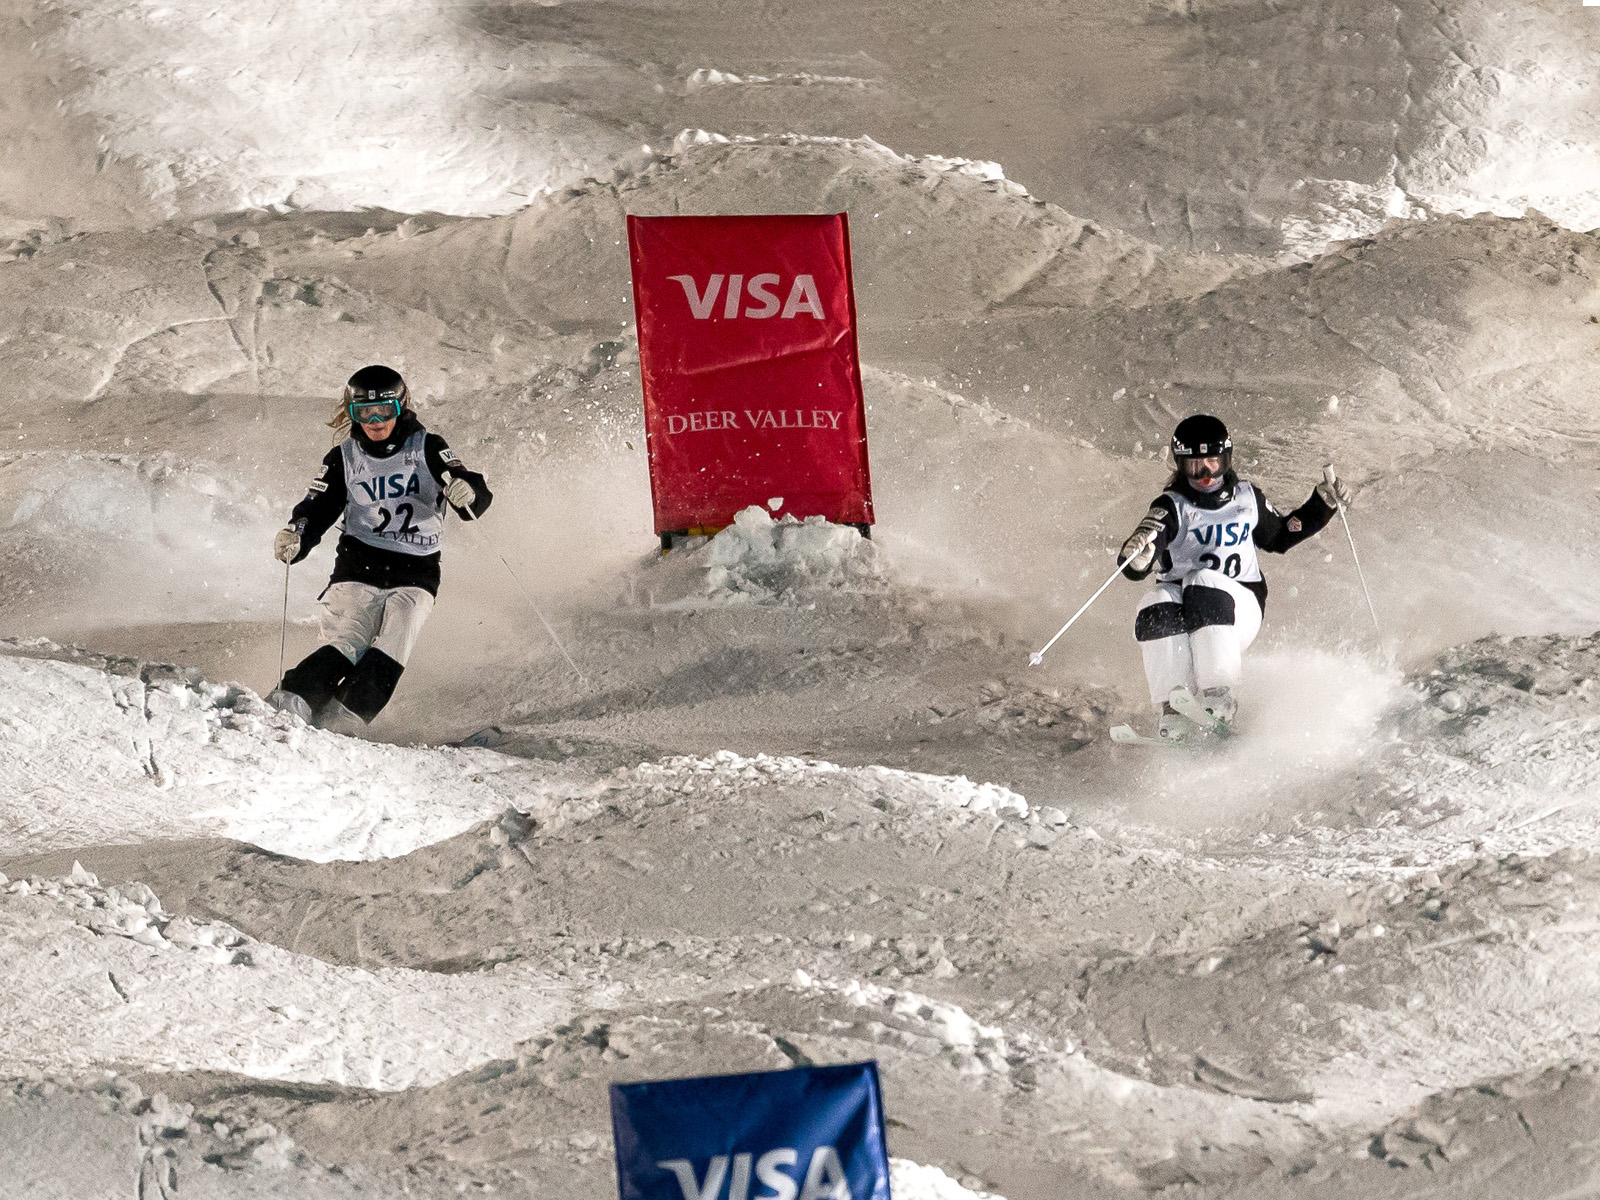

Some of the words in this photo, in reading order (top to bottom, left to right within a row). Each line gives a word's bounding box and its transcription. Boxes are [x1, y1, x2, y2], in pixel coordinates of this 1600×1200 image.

[666, 273, 826, 320] VISA
[667, 411, 740, 435] DEER
[745, 409, 843, 431] VALLEY
[355, 473, 420, 502] VISA
[373, 502, 420, 533] 22
[1188, 522, 1250, 547] VISA
[656, 1145, 852, 1200] VISA
